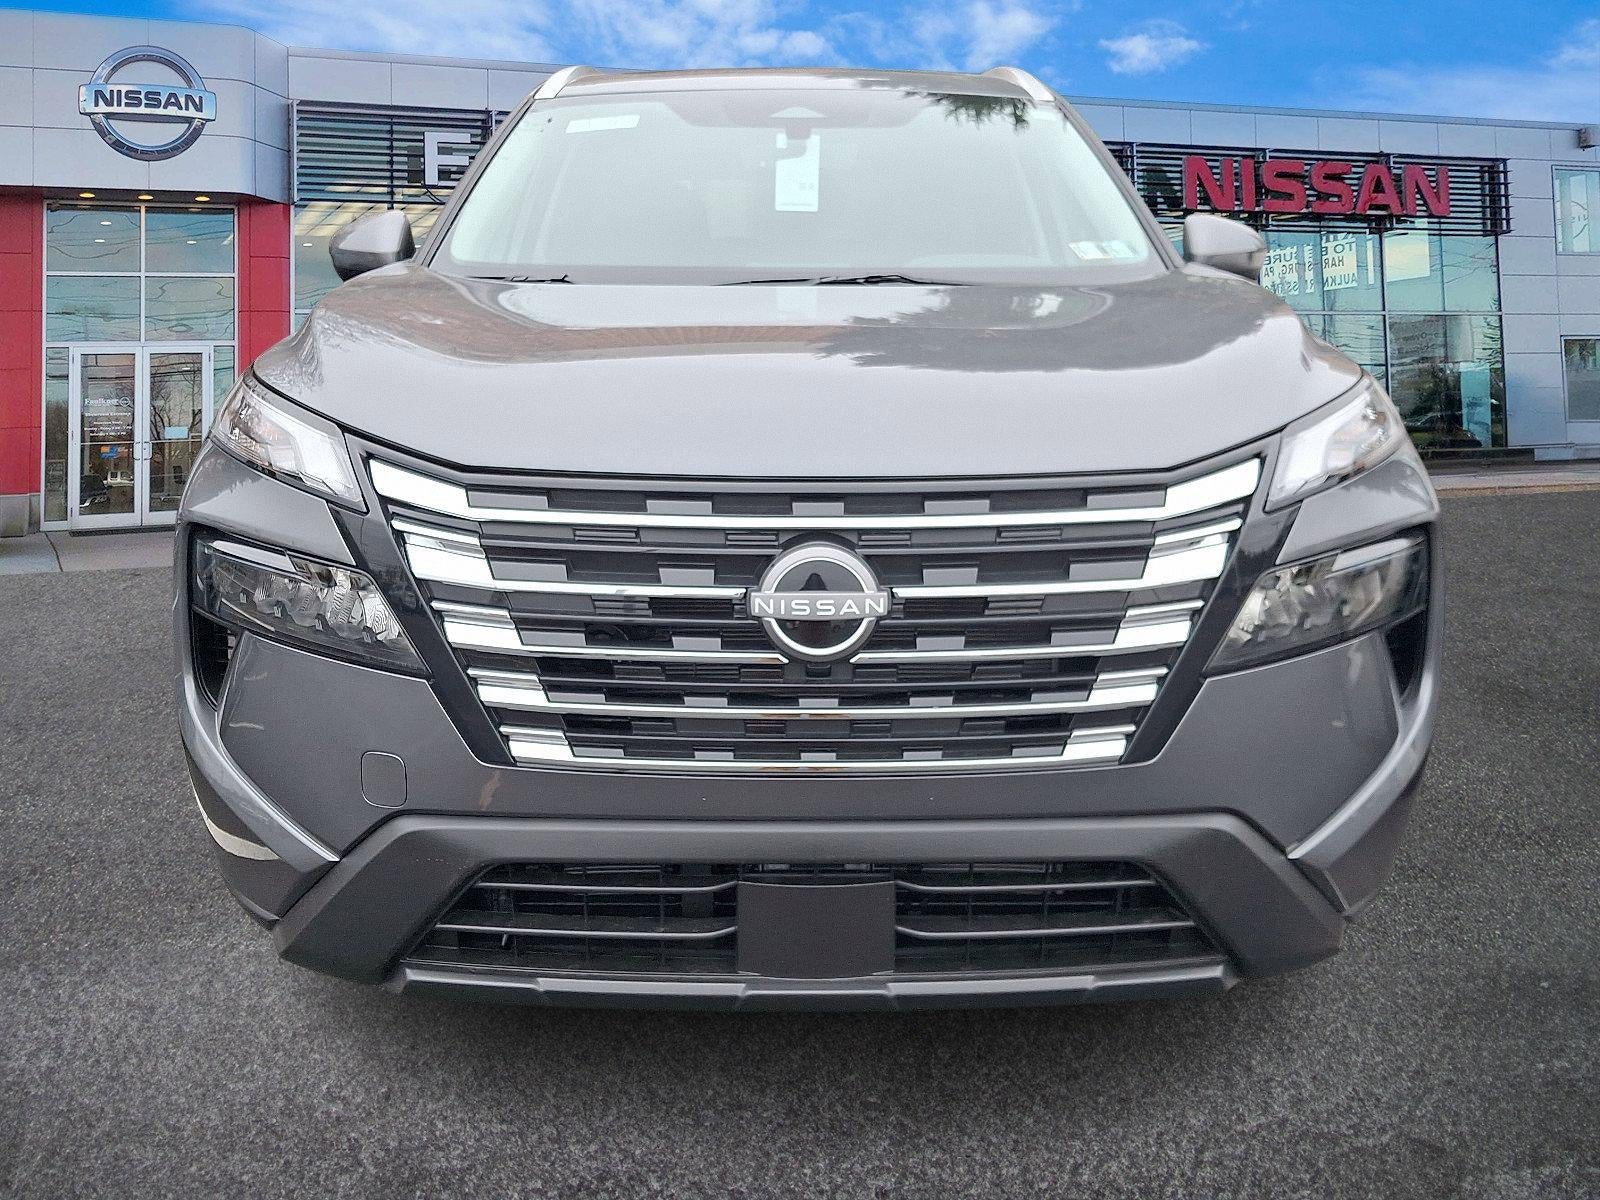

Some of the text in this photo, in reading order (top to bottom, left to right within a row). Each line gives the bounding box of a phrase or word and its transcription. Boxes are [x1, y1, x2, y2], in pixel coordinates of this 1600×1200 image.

[93, 89, 204, 113] NISSAN
[1183, 155, 1451, 217] NISSAN
[754, 597, 885, 616] NISSAN
